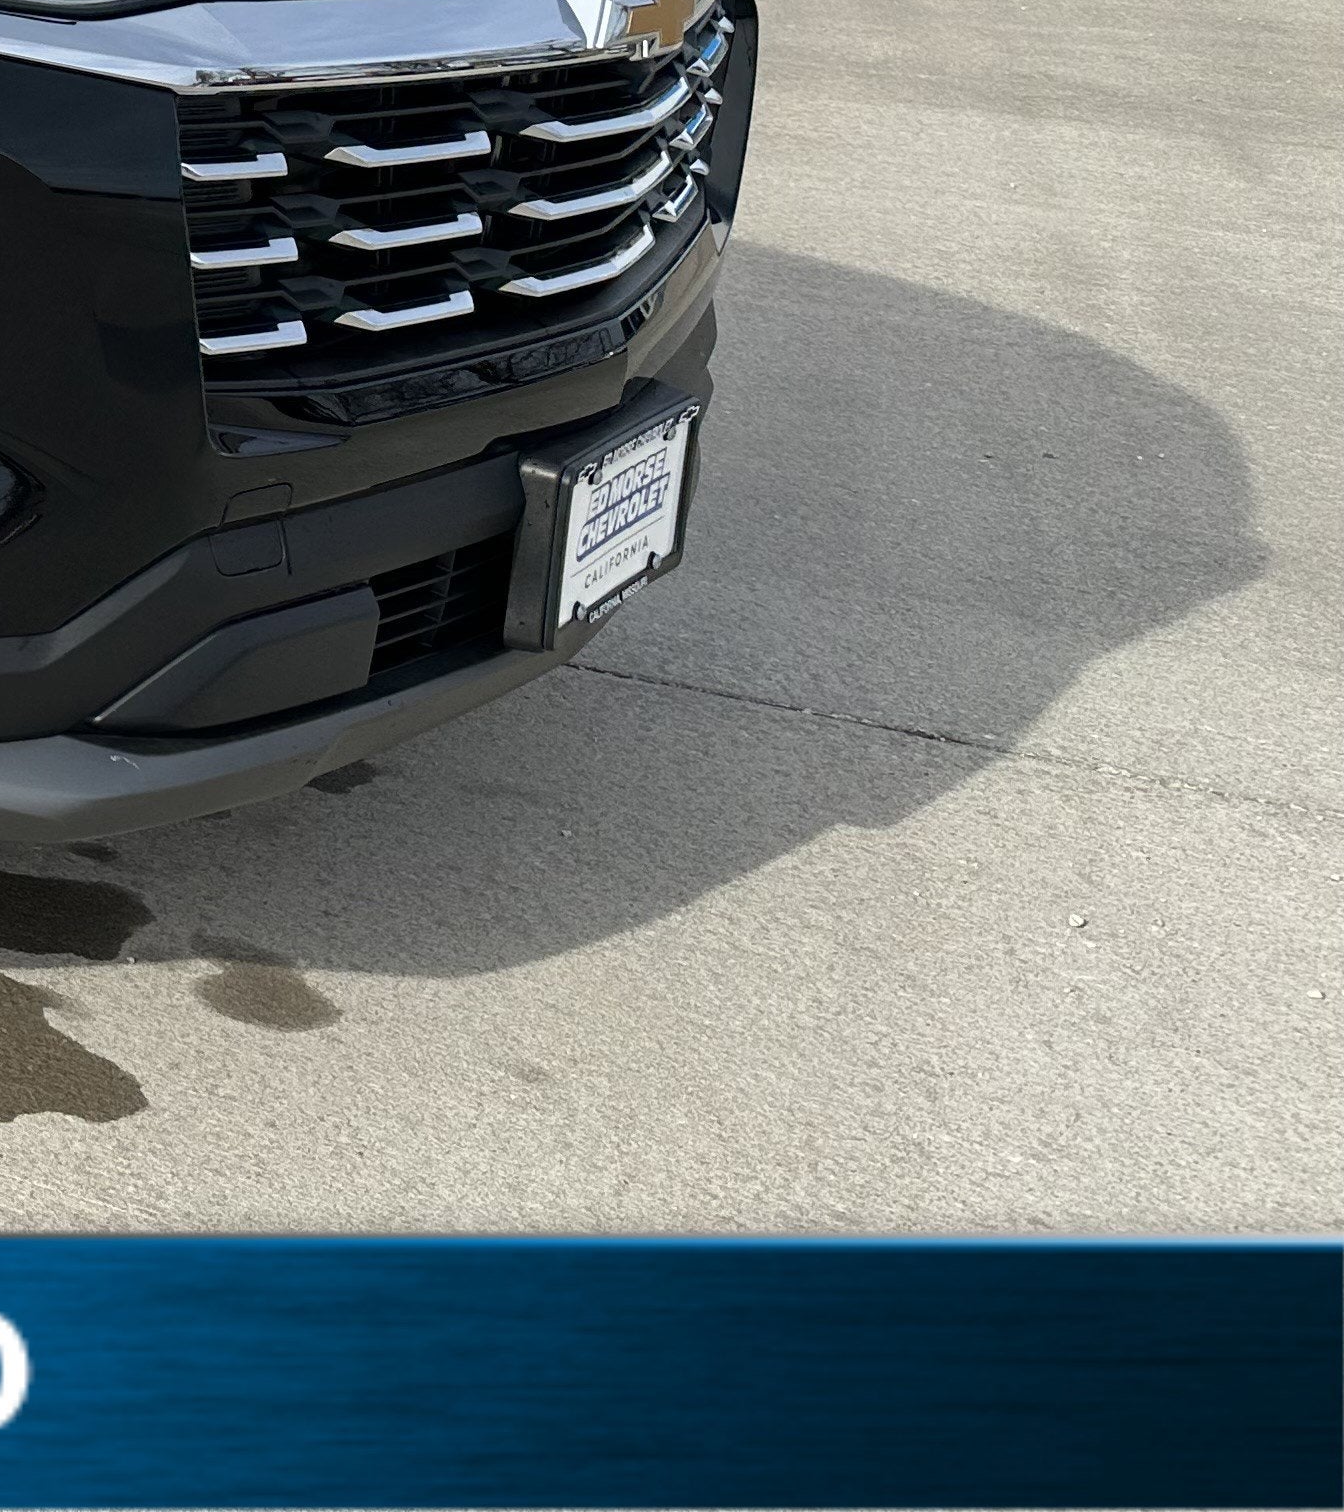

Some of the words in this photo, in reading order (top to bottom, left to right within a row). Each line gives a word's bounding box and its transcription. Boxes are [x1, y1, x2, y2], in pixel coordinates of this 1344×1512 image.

[589, 482, 612, 517] ED
[609, 447, 667, 507] MORSE
[577, 474, 670, 561] CHEVROLET
[584, 535, 649, 589] CALIFORNIA
